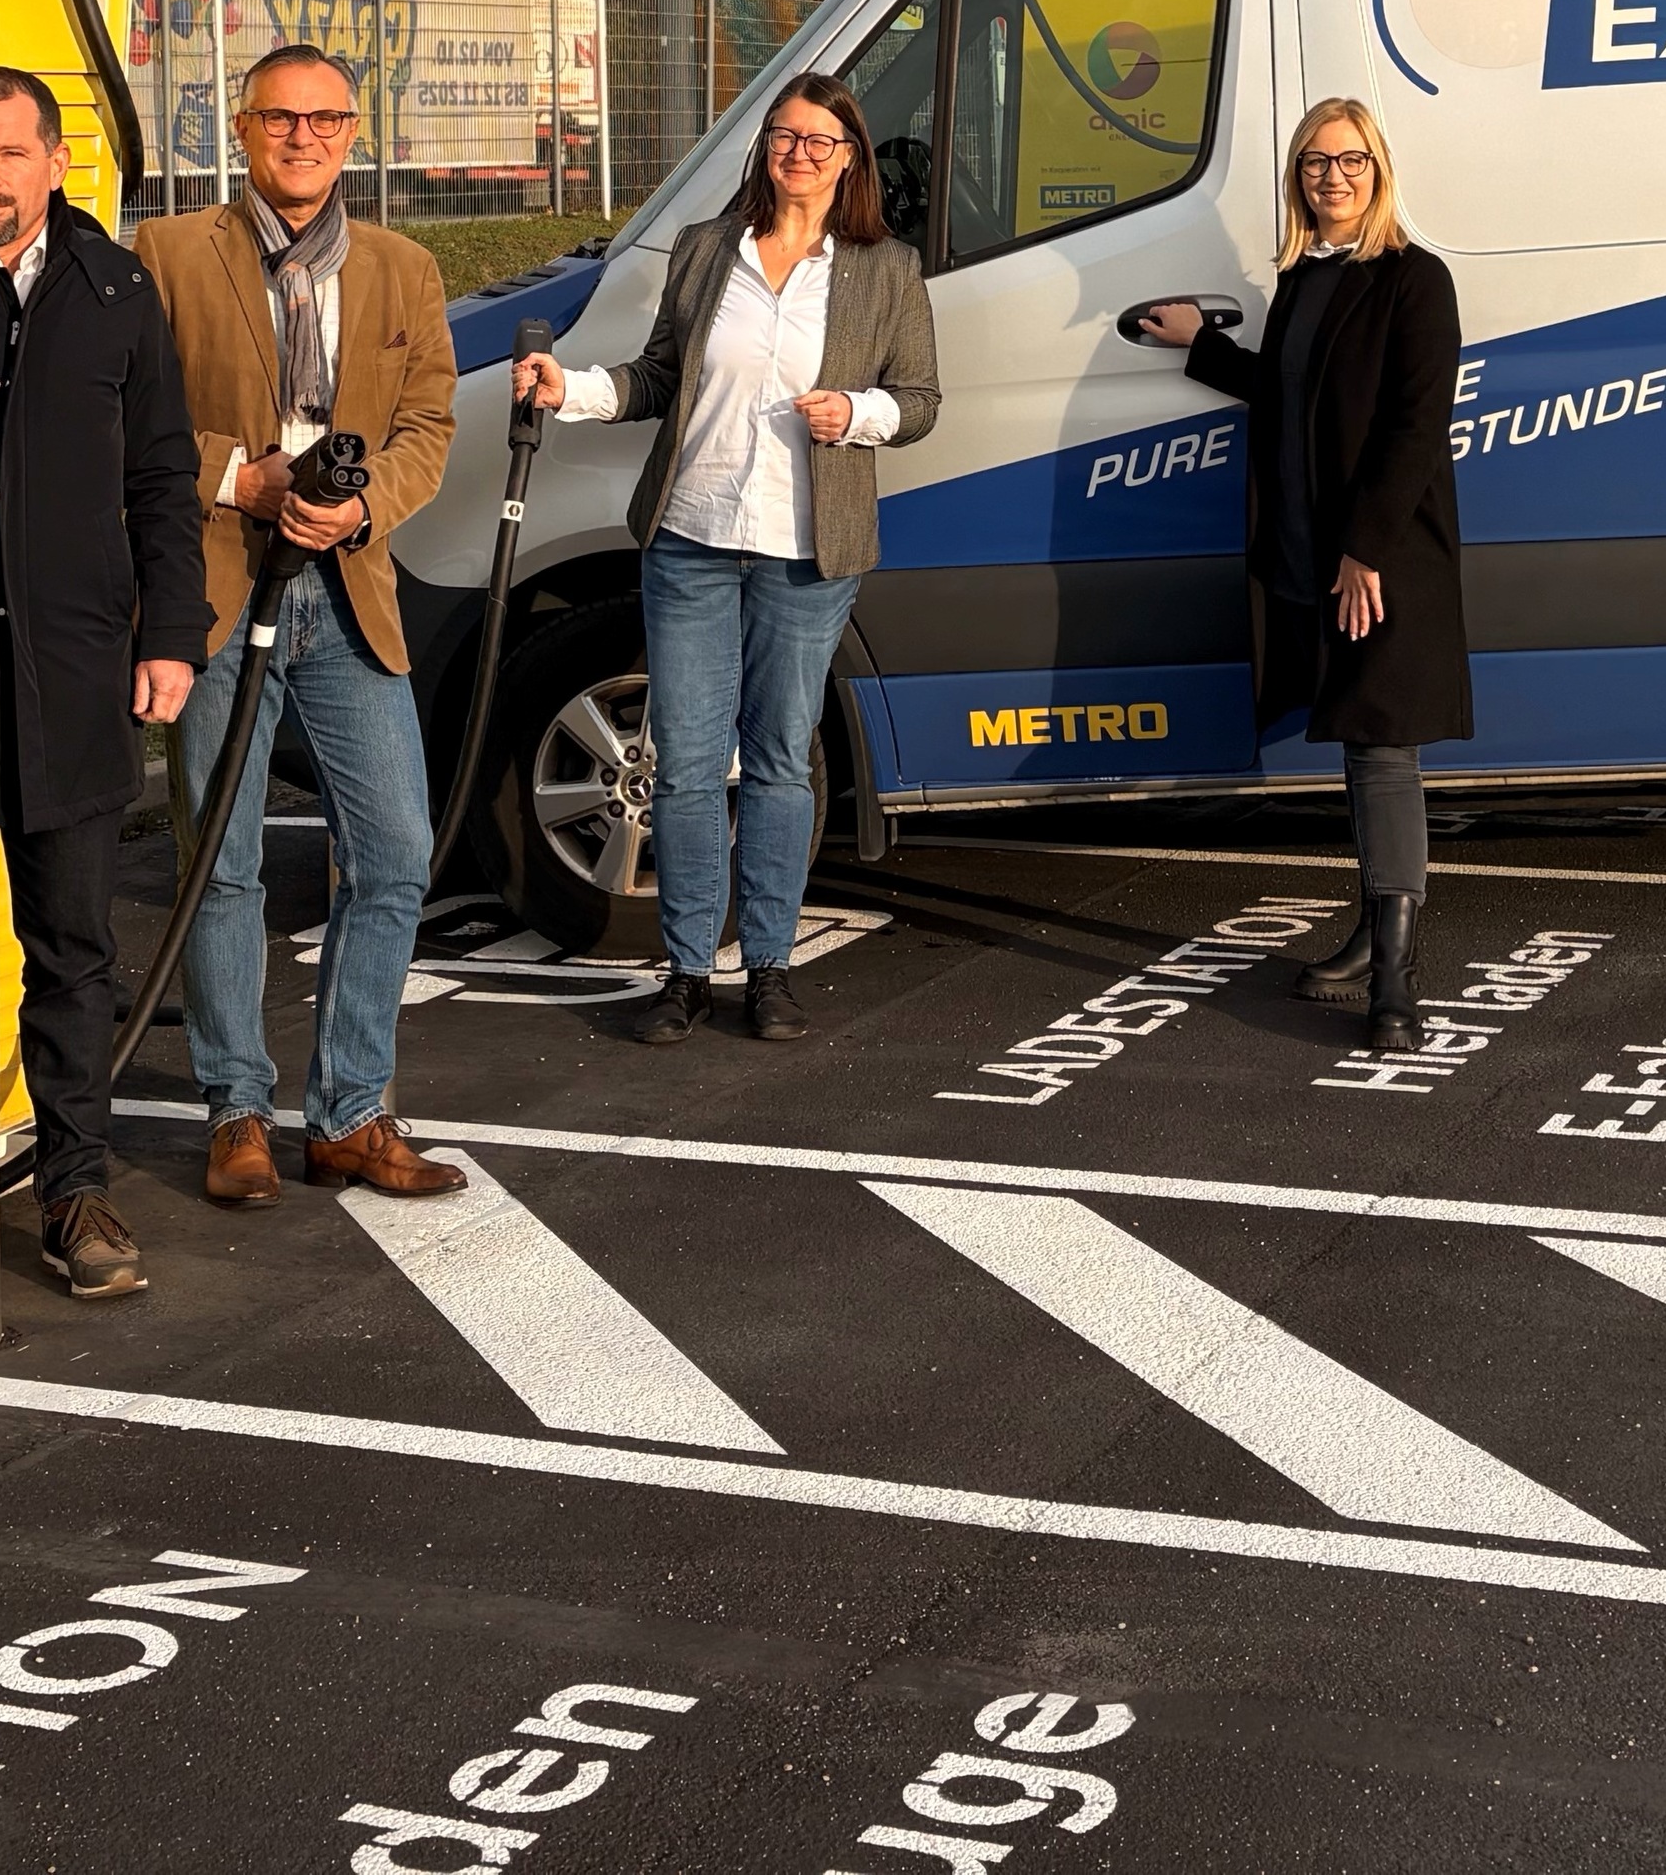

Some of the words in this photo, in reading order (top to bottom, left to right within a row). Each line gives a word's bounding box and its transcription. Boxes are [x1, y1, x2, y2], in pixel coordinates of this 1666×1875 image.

[1044, 189, 1111, 204] METRO
[1086, 424, 1235, 498] PURE
[969, 702, 1169, 748] METRO
[931, 895, 1351, 1105] LADESTATION
[1310, 1015, 1505, 1094] Hier
[1416, 930, 1617, 1012] laden
